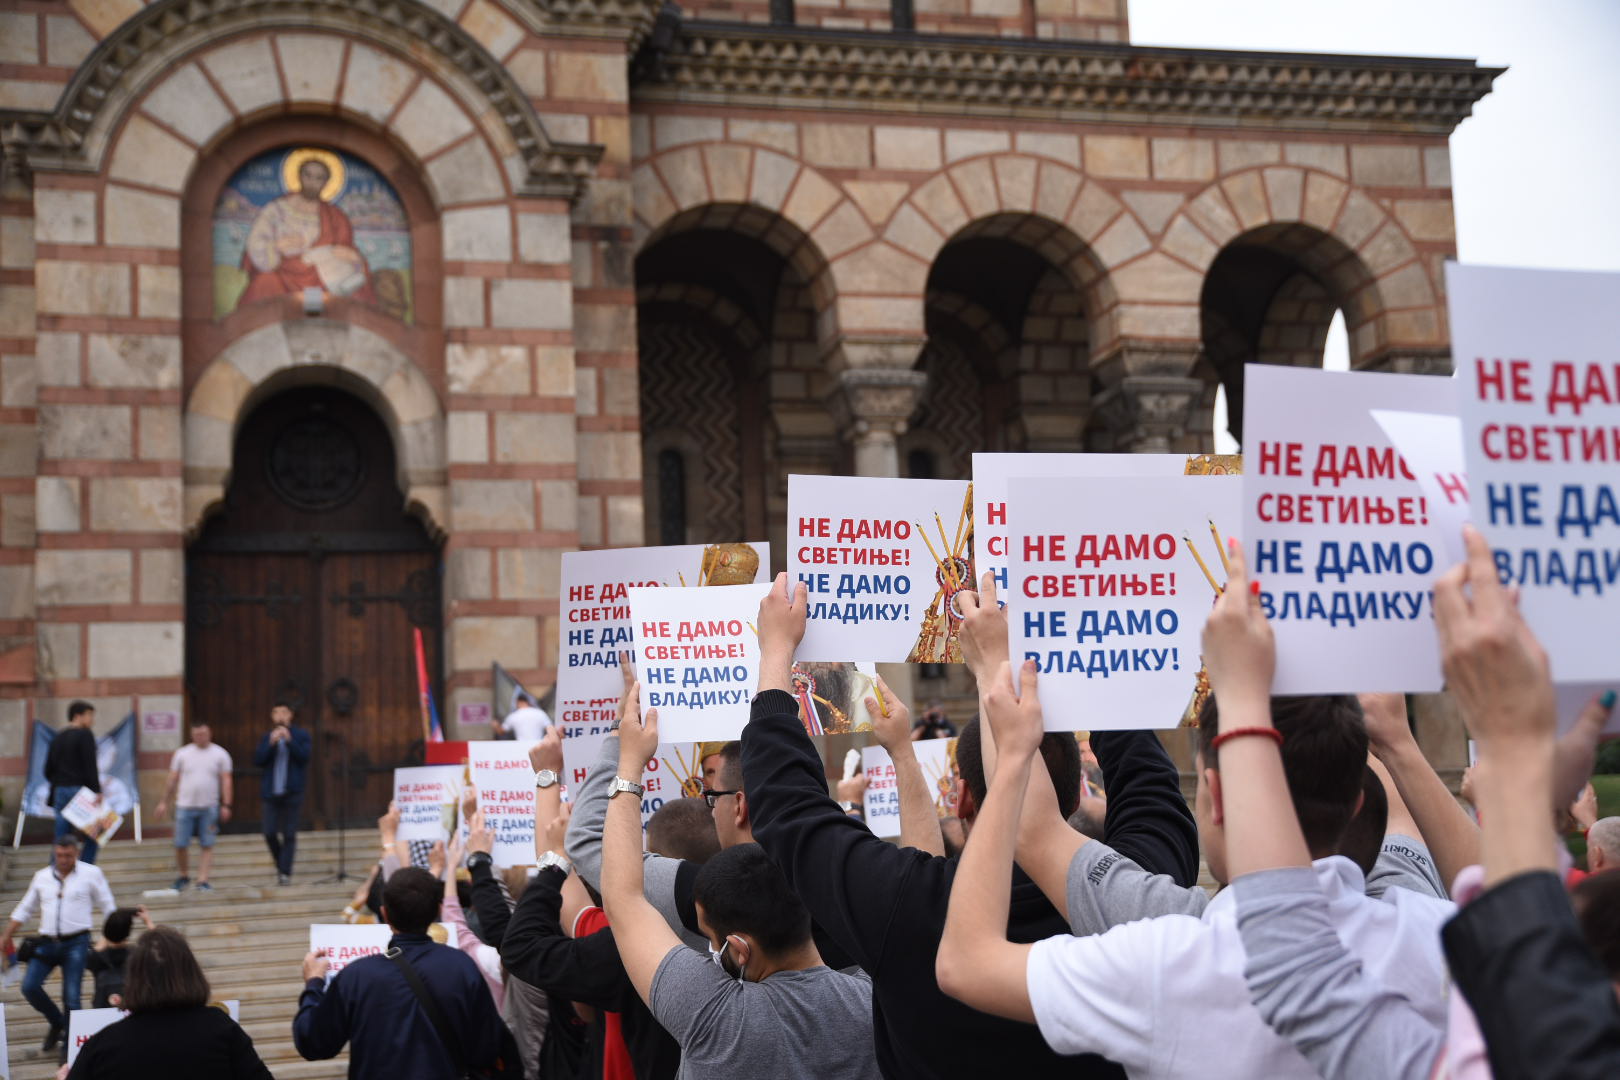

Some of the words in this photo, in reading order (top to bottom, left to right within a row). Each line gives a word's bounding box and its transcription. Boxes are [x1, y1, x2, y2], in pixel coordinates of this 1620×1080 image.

[1475, 357, 1533, 402] НЕ
[1546, 362, 1620, 416] ДА
[1481, 422, 1620, 463] СВЕТИ
[1259, 441, 1303, 477] НЕ
[1434, 473, 1470, 504] Н
[987, 502, 1007, 526] Н
[1257, 492, 1429, 526] СВЕТИЊЕ!
[1486, 483, 1542, 526] НЕ
[1556, 484, 1620, 538] ДА
[798, 517, 831, 538] НЕ
[836, 518, 911, 544] ДАМО
[797, 546, 910, 567] СВЕТИЊЕ!
[1023, 535, 1066, 562] НЕ
[1075, 533, 1177, 569] ДАМО
[1255, 539, 1304, 574] НЕ
[1315, 540, 1434, 583] ДАМО
[988, 567, 1008, 590] Н
[1492, 548, 1620, 595] ВЛАДИ
[568, 584, 595, 602] НЕ
[798, 573, 830, 593] НЕ
[836, 574, 911, 599] ДАМО
[1022, 572, 1176, 598] СВЕТИЊЕ!
[568, 605, 631, 623] СВЕТИ
[1024, 610, 1067, 638] НЕ
[1076, 608, 1179, 643] ДАМО
[568, 628, 595, 646] НЕ
[599, 626, 633, 648] ДА
[642, 621, 671, 638] НЕ
[677, 619, 743, 642] ДАМО
[644, 643, 745, 659] СВЕТИЊЕ!
[1024, 647, 1180, 679] ВЛАДИКУ!
[647, 667, 676, 684] НЕ
[682, 665, 748, 688] ДАМО
[649, 689, 749, 709] ВЛАДИКУ!
[562, 709, 616, 722] СВЕТИ
[475, 760, 490, 769] НЕ
[494, 759, 529, 770] ДАМО
[573, 767, 587, 783] Н
[481, 790, 497, 801] НЕ
[500, 790, 535, 803] ДАМО
[868, 793, 885, 804] НЕ
[484, 818, 498, 830] НЕ
[502, 818, 535, 831] ДАМО
[1384, 844, 1427, 866] SECURIT
